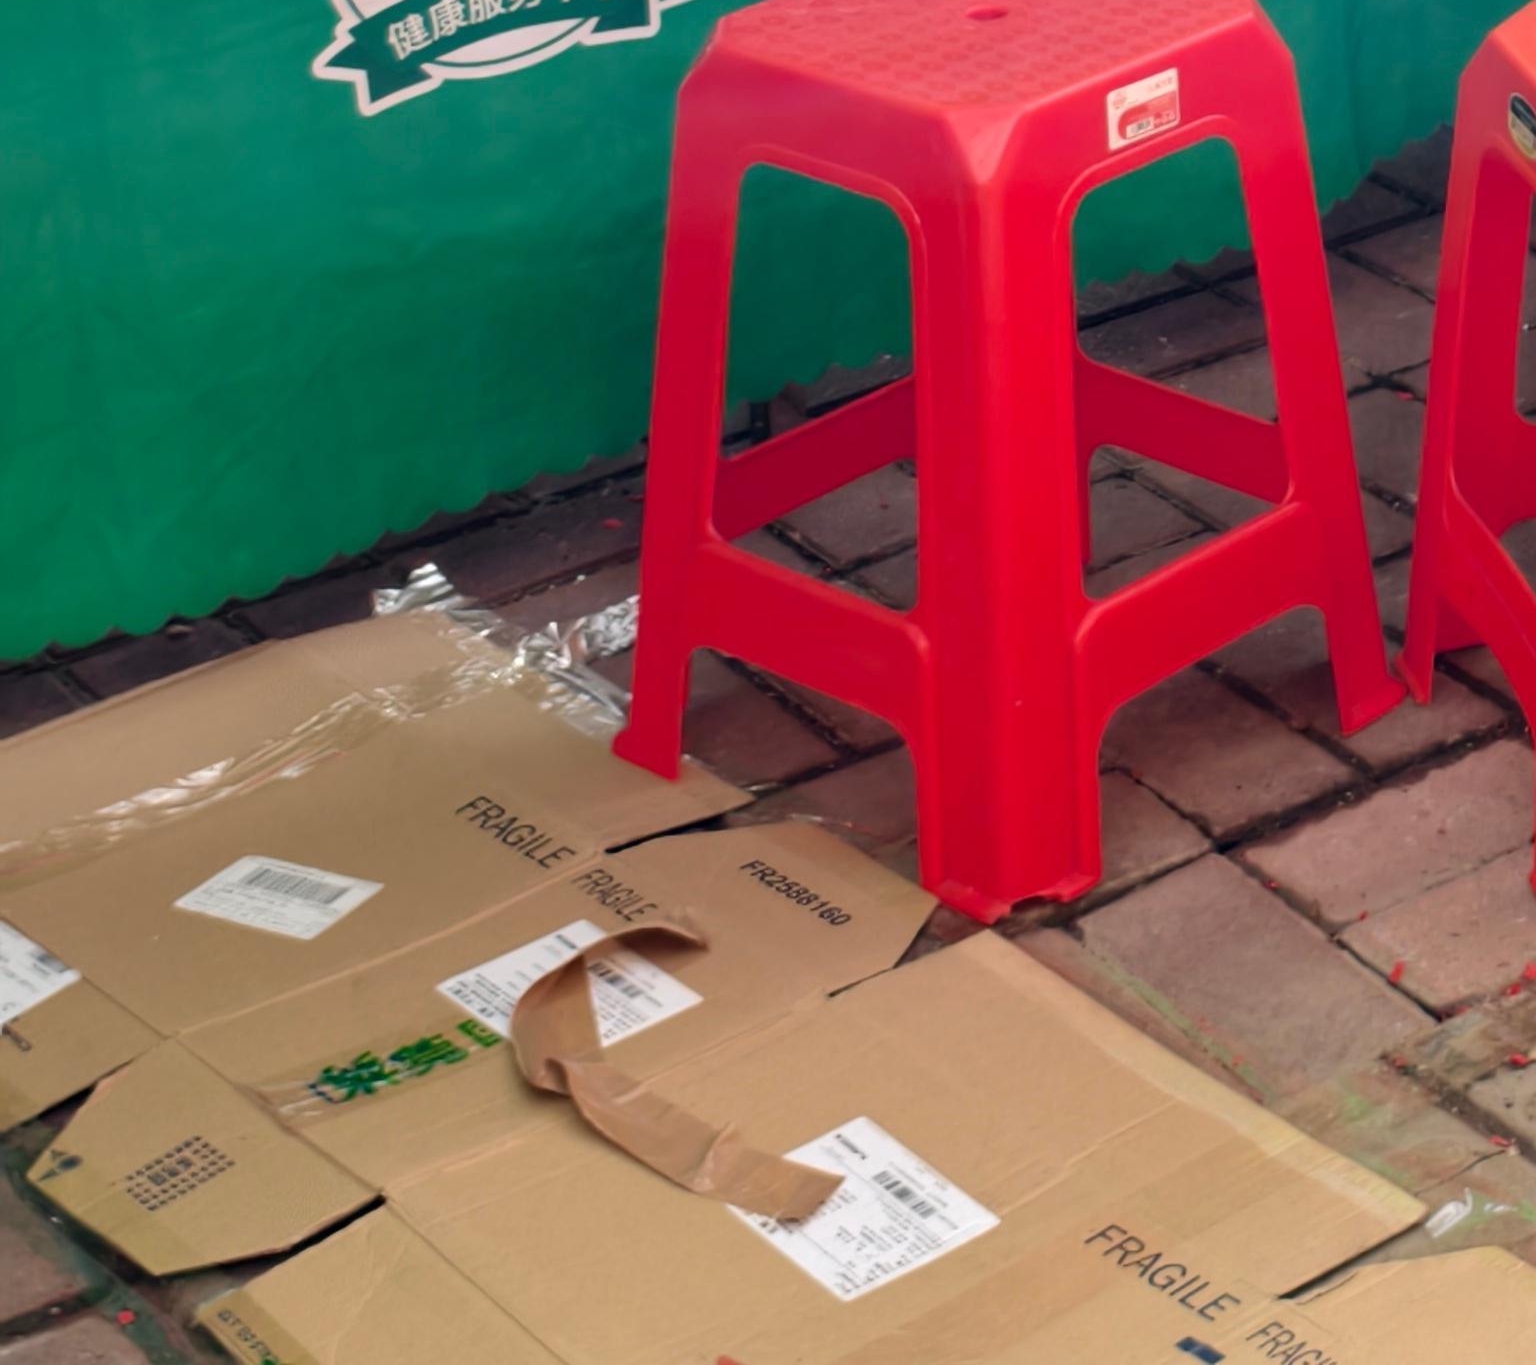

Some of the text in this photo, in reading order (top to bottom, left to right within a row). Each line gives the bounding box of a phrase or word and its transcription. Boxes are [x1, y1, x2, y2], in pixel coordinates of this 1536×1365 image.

[455, 794, 577, 870] FRAGILE
[570, 867, 659, 924] FRAGILE
[1083, 1222, 1242, 1324] FRAGILE
[1245, 1319, 1341, 1365] FRAG
